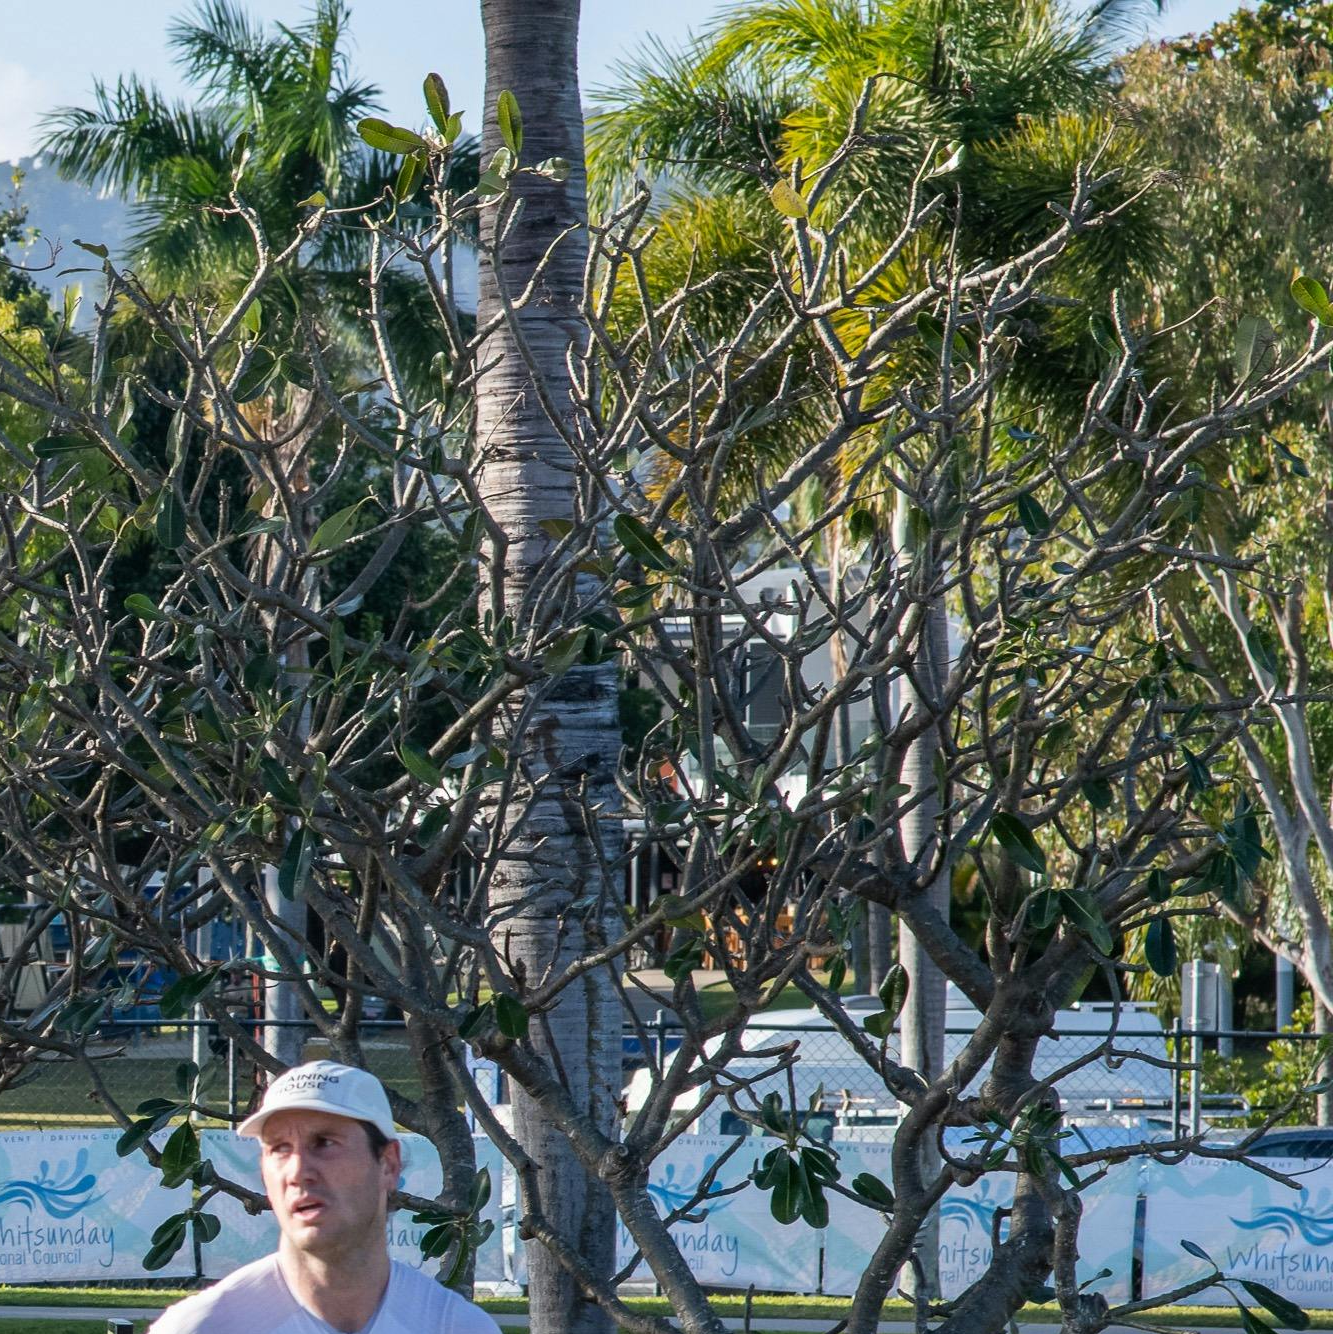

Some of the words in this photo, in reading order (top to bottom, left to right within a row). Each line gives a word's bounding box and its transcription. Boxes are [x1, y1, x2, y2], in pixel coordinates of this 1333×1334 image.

[288, 1073, 339, 1083] AINING
[50, 1133, 98, 1142] DRIVING
[33, 1250, 82, 1265] Council
[1227, 1242, 1333, 1280] Whitsun
